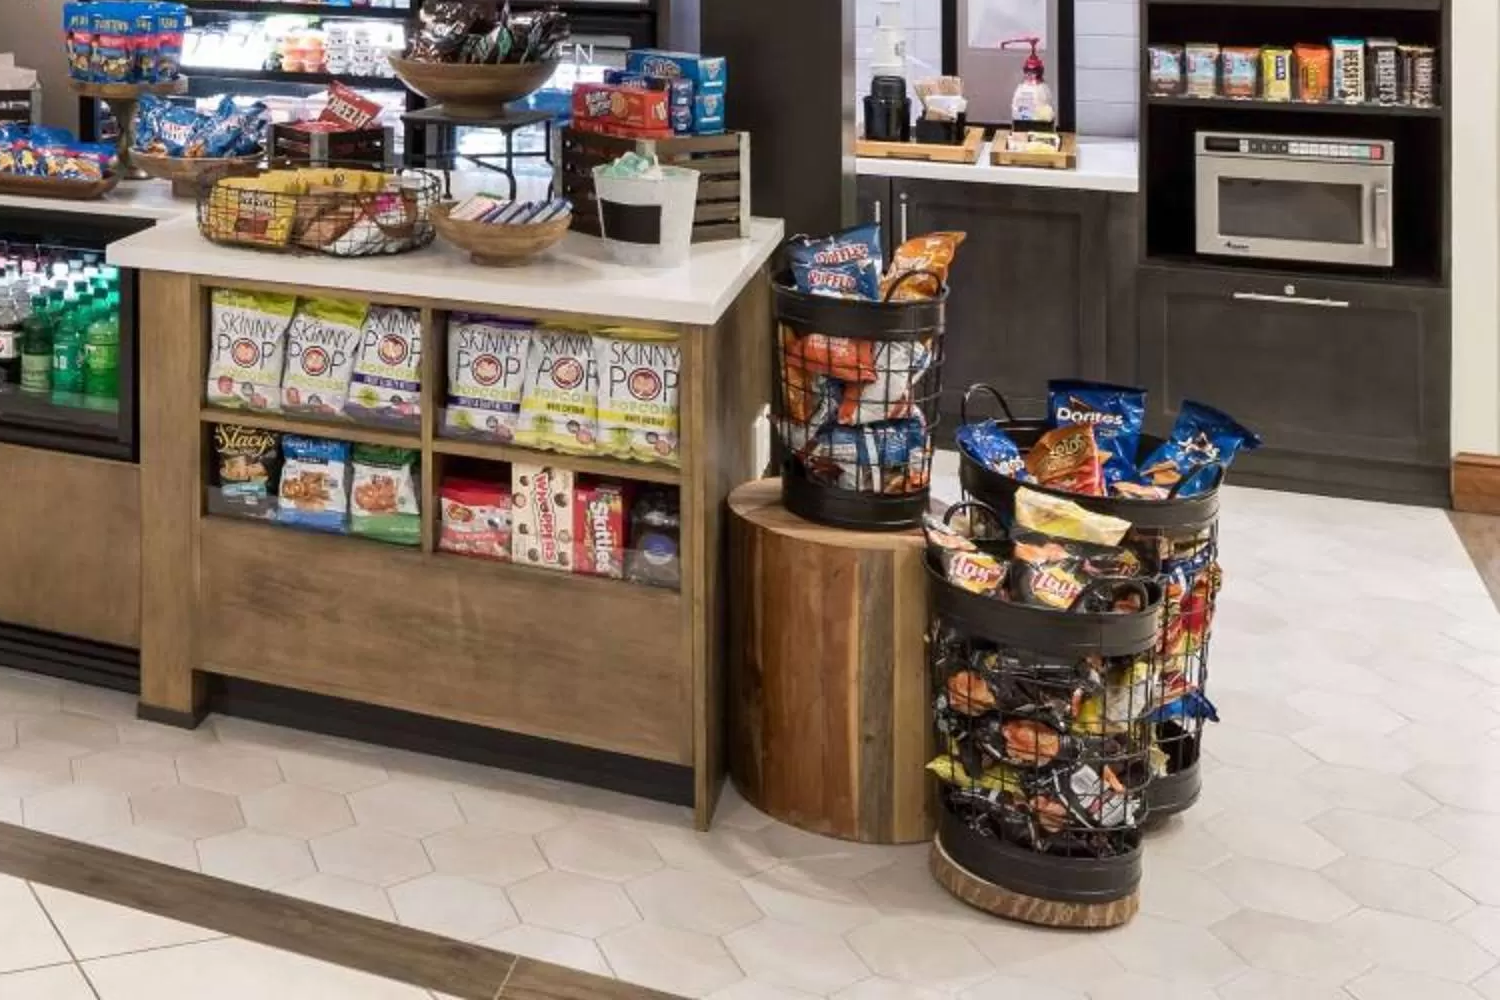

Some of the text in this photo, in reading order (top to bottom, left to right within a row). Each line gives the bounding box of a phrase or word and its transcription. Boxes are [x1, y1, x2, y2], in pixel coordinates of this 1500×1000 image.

[216, 333, 277, 370] POP
[458, 326, 525, 353] SKINNY
[609, 340, 681, 368] SKINNY
[455, 350, 521, 388] POP
[1056, 407, 1124, 427] Doritos
[534, 472, 558, 563] WHOPPERS
[590, 500, 612, 572] Skittles
